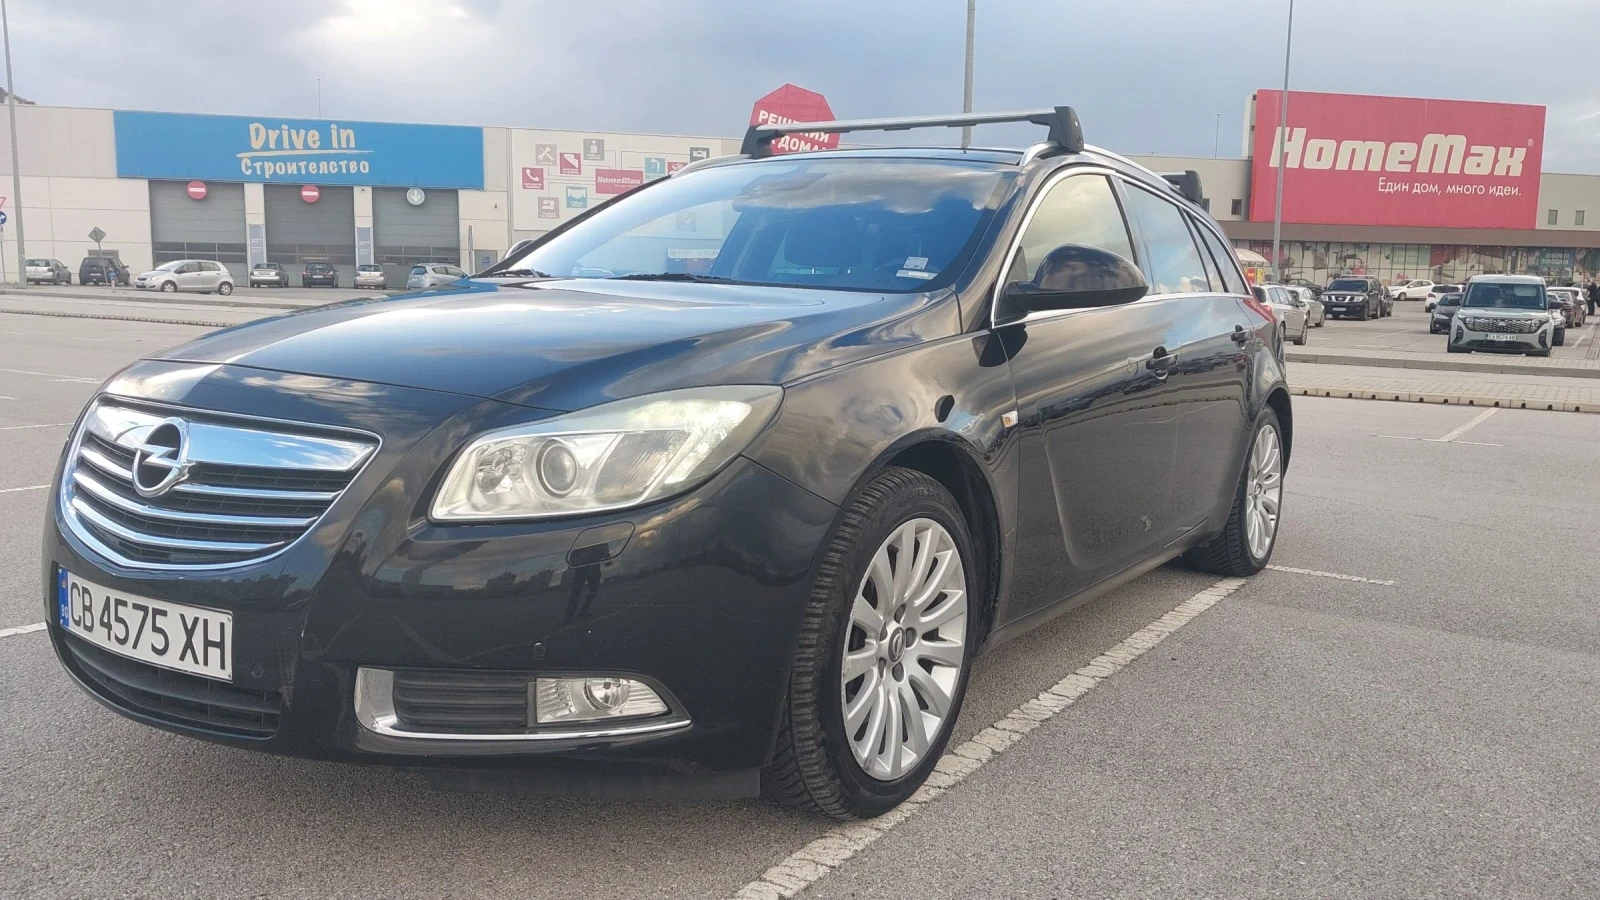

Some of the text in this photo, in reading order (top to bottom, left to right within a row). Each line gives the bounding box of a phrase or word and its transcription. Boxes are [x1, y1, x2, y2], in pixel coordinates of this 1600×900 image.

[249, 122, 356, 150] Drive in
[1269, 126, 1527, 177] HomeMax
[241, 157, 369, 179] Строителство
[597, 176, 641, 185] HomeMax
[1378, 177, 1523, 197] Един дом, много идеи.
[70, 582, 226, 670] CB 4575 XH
